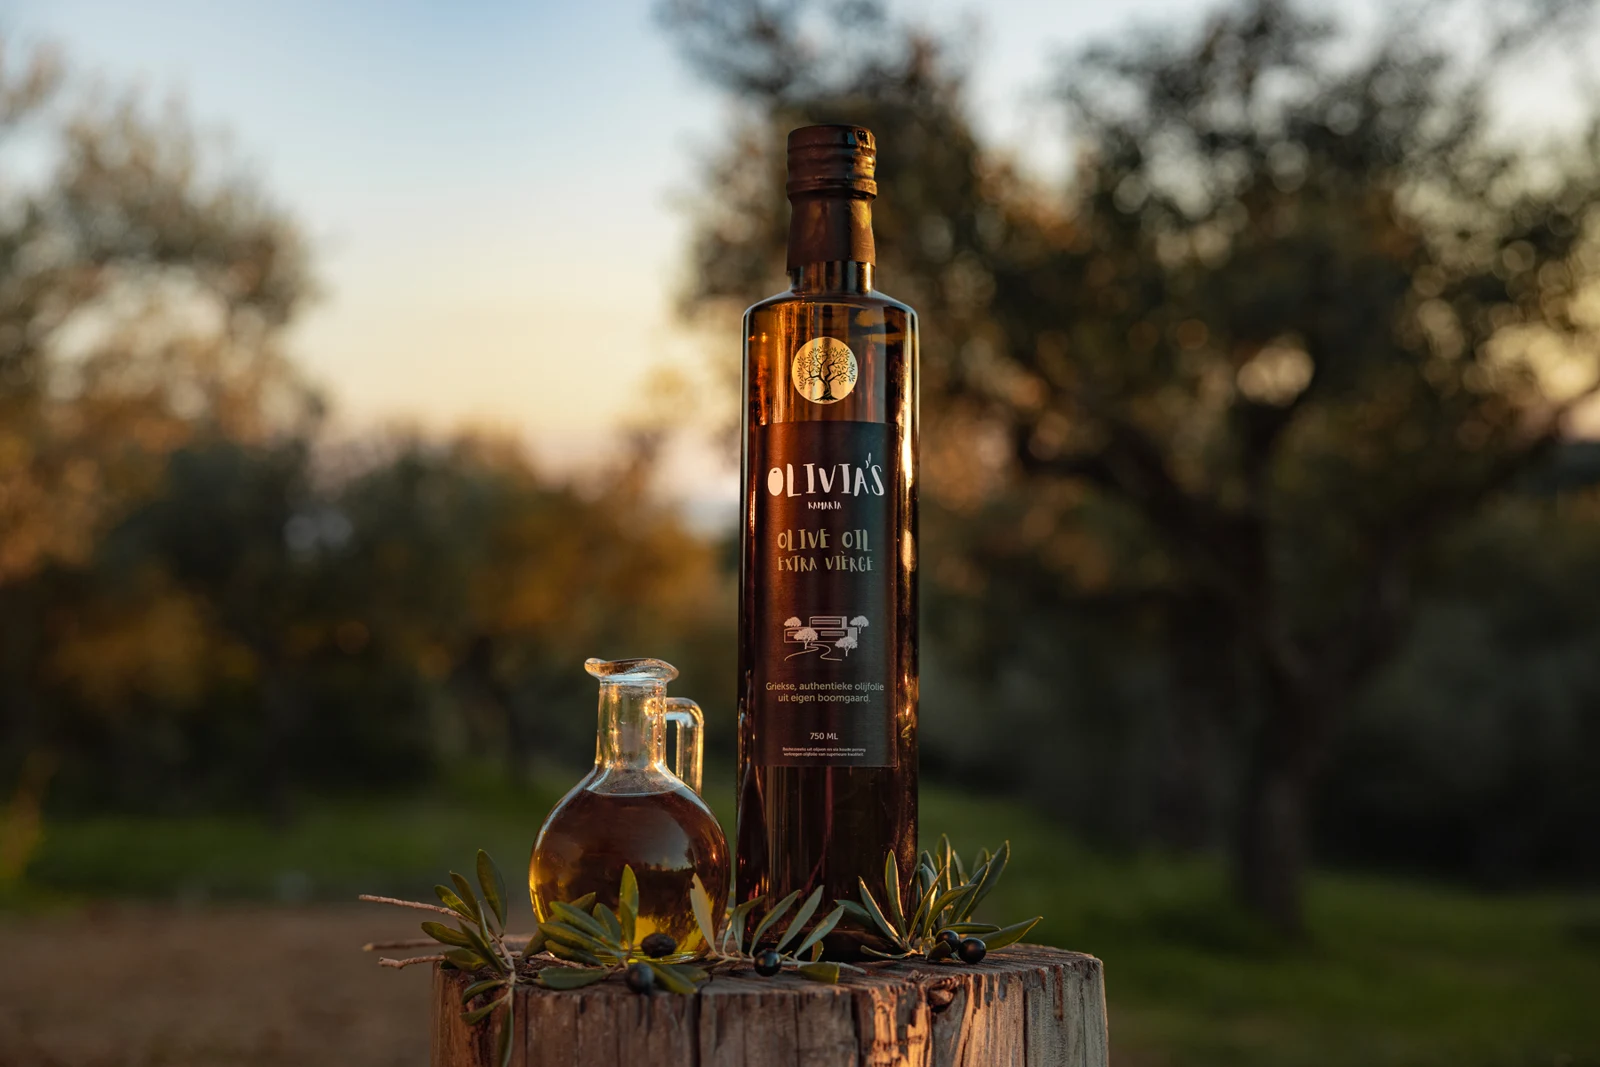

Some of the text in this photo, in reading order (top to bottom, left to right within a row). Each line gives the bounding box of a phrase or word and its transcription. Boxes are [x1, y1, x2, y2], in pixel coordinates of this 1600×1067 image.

[777, 528, 873, 552] OLIVE OIL
[778, 551, 873, 572] EXTRA VIÈRGE
[765, 682, 885, 693] Griekse, authentieke olijfolie
[778, 693, 871, 704] uit eigen boomgaard.
[809, 732, 838, 740] 750 ML
